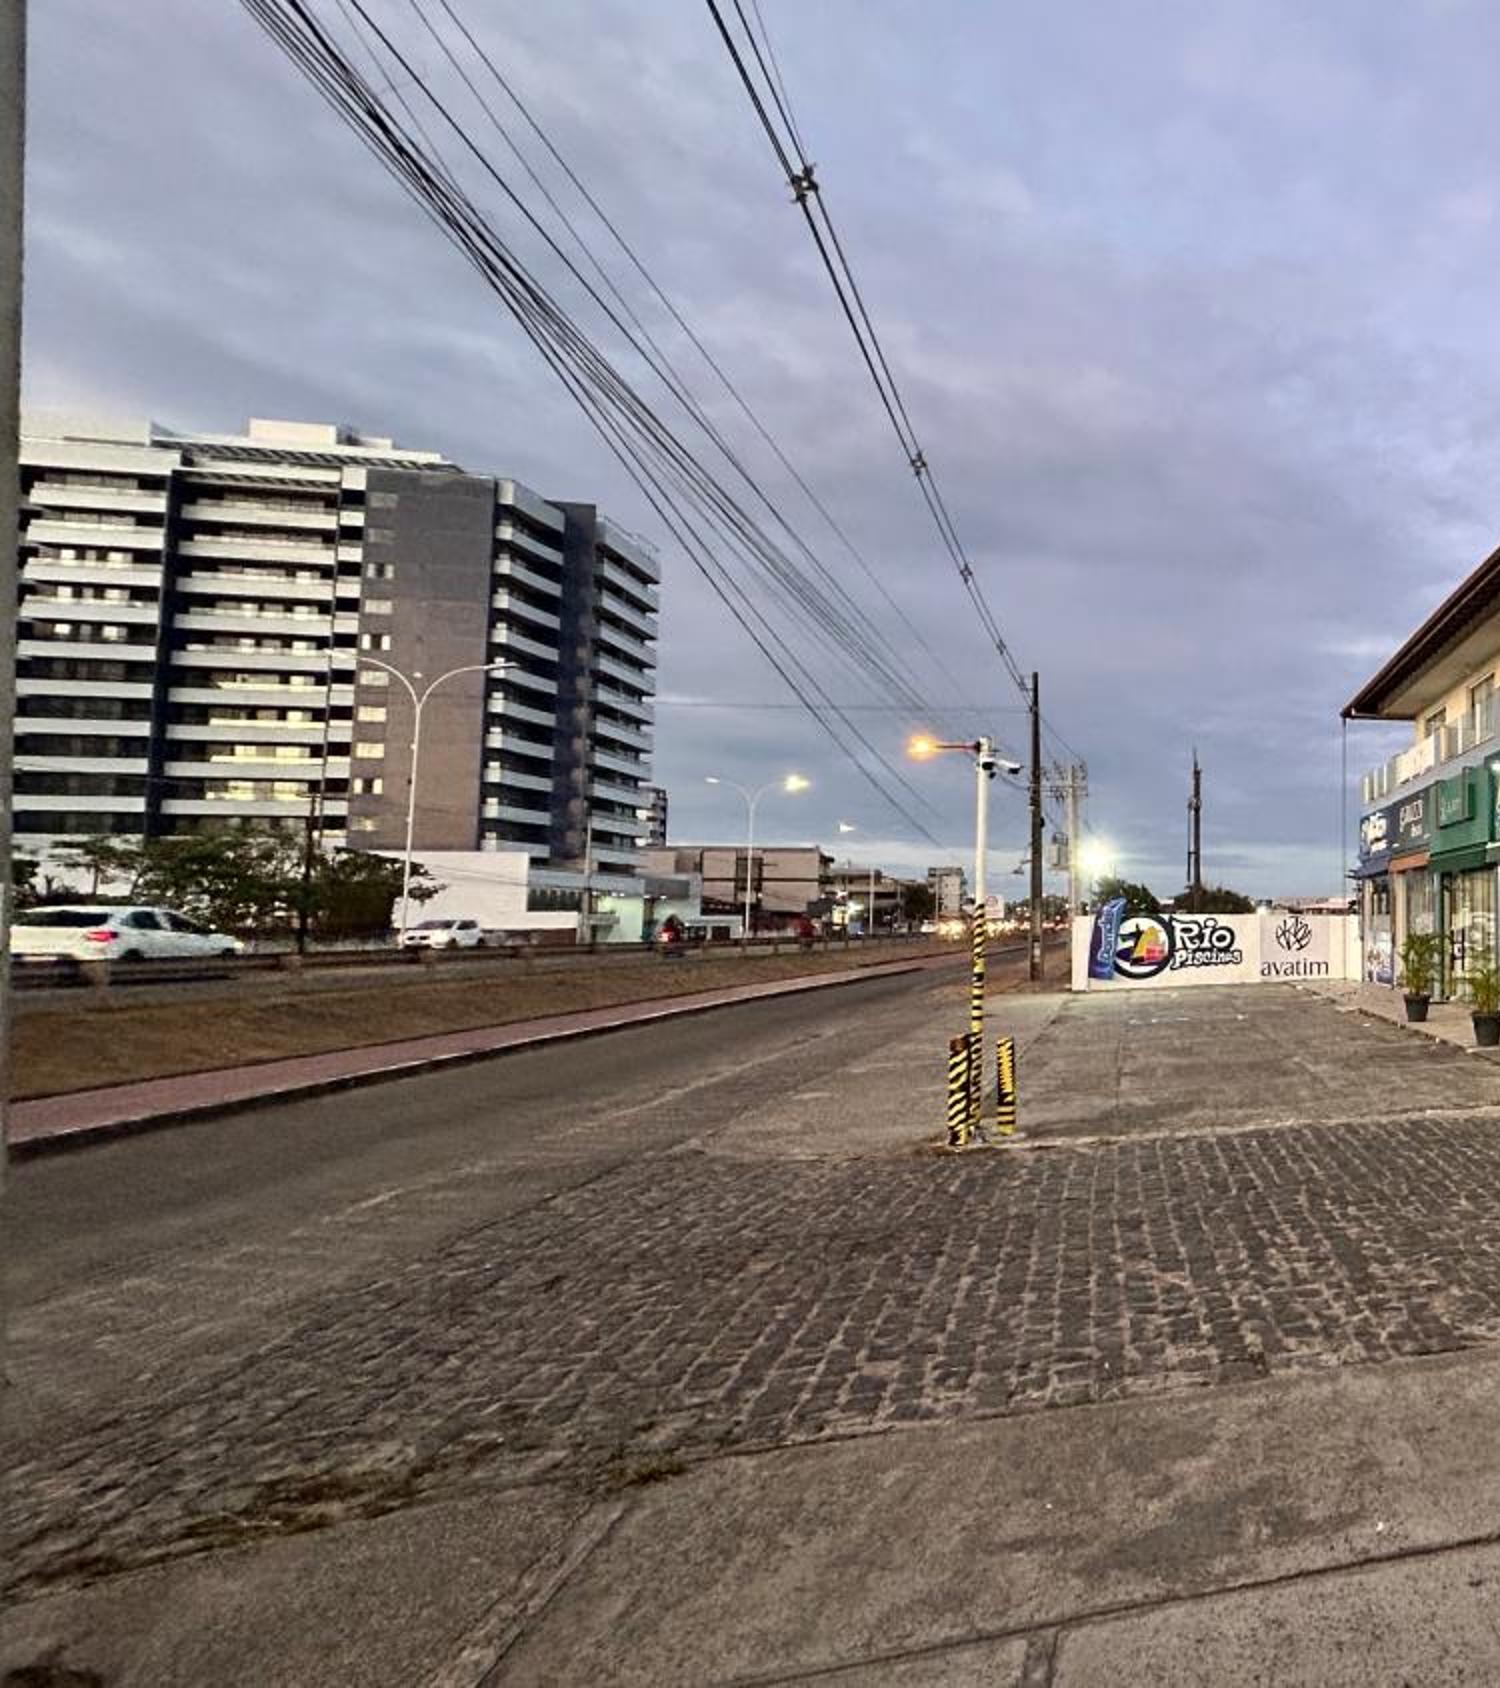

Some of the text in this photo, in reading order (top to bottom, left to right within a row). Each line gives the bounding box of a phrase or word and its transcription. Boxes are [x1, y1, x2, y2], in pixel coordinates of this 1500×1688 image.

[1171, 917, 1233, 949] Rio
[1171, 950, 1242, 968] Piscinas
[1260, 958, 1329, 976] avatim
